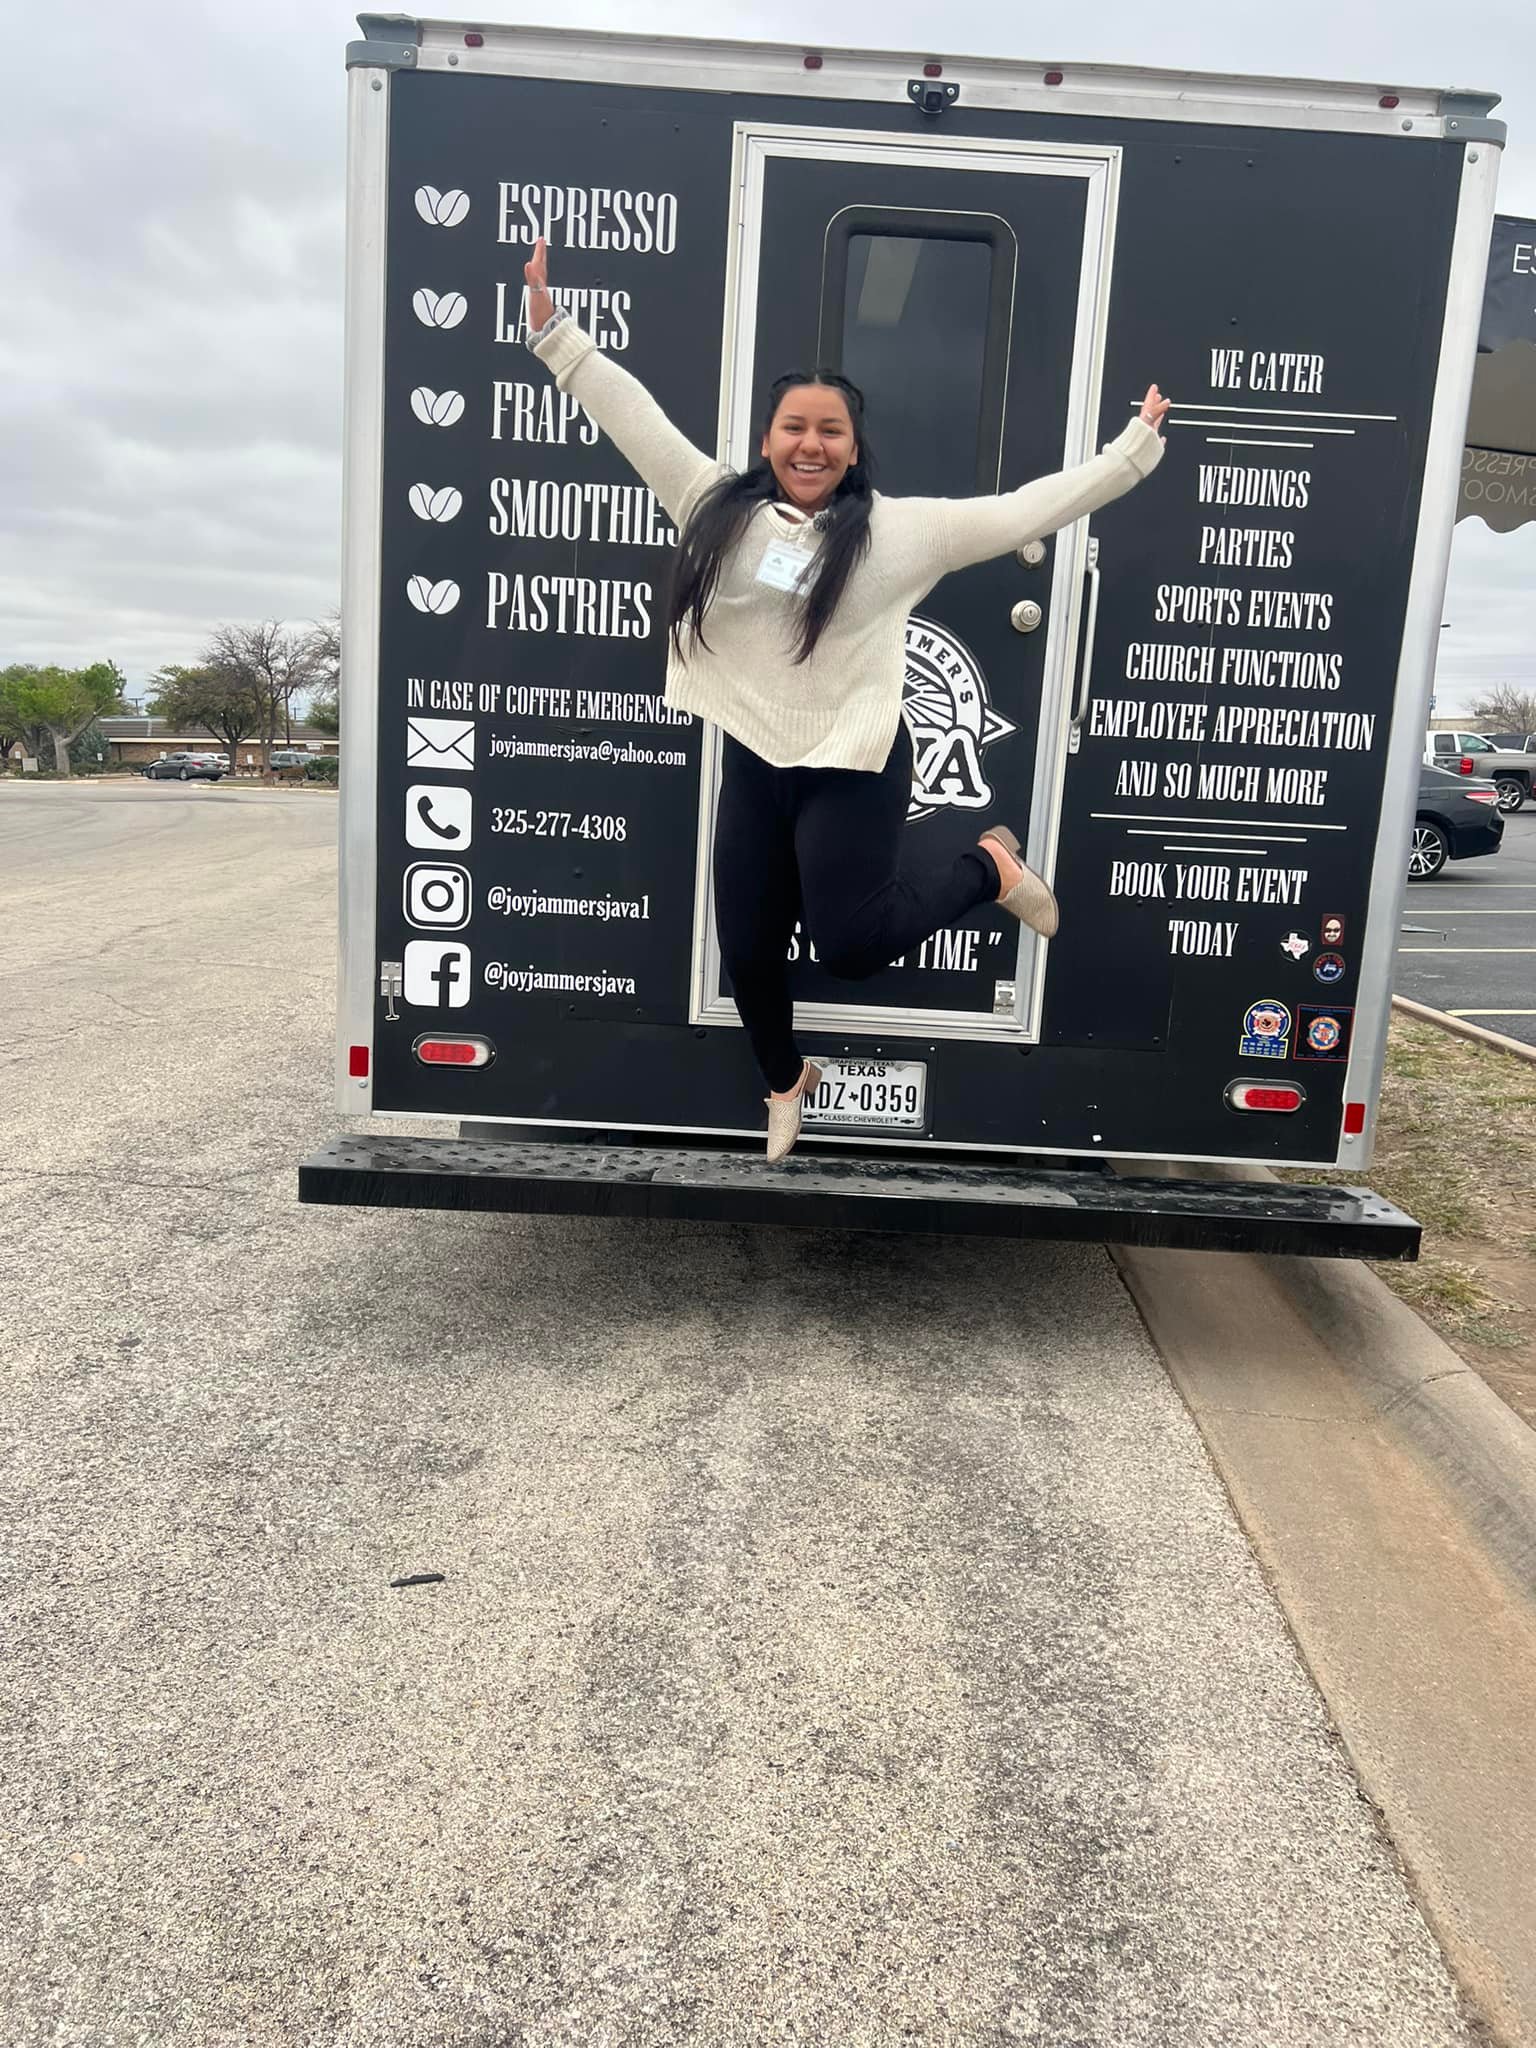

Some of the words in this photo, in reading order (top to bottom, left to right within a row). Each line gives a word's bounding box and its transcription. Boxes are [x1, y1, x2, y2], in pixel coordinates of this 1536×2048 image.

[496, 181, 678, 255] ESPRESSO
[1211, 349, 1244, 388] WE
[1250, 352, 1324, 393] CATER
[1199, 465, 1310, 508] WEDDINGS
[1199, 526, 1294, 568] PARTIES
[486, 572, 652, 638] PASTRIES
[1155, 585, 1242, 625] SPORTS
[1247, 590, 1333, 630] EVENTS
[1126, 643, 1216, 683] CHURCH
[1220, 648, 1342, 690] FUNCTIONS
[408, 679, 424, 707] IN
[431, 680, 473, 711] CASE
[479, 684, 500, 712] OF
[506, 686, 571, 718] COFFEE
[1089, 699, 1208, 742] EMPLOYEE
[1212, 706, 1376, 750] APPRECIATION
[489, 734, 687, 766] joyjammersjava@yahoo.com
[1115, 761, 1157, 796] AND
[1164, 763, 1192, 798] SO
[1197, 765, 1261, 802] MUCH
[1265, 768, 1327, 805] MORE
[491, 807, 627, 842] 325-277-4308
[487, 886, 650, 921] @joyjammersjava1
[1110, 862, 1167, 897] BOOK
[1176, 864, 1230, 900] YOUR
[1236, 868, 1308, 904] EVENT
[1169, 920, 1238, 956] TODAY
[484, 961, 636, 995] @joyjammersjava
[838, 1064, 887, 1078] TEXAS
[823, 1114, 852, 1122] CLASSIC
[853, 1116, 894, 1124] CHEVROLET
